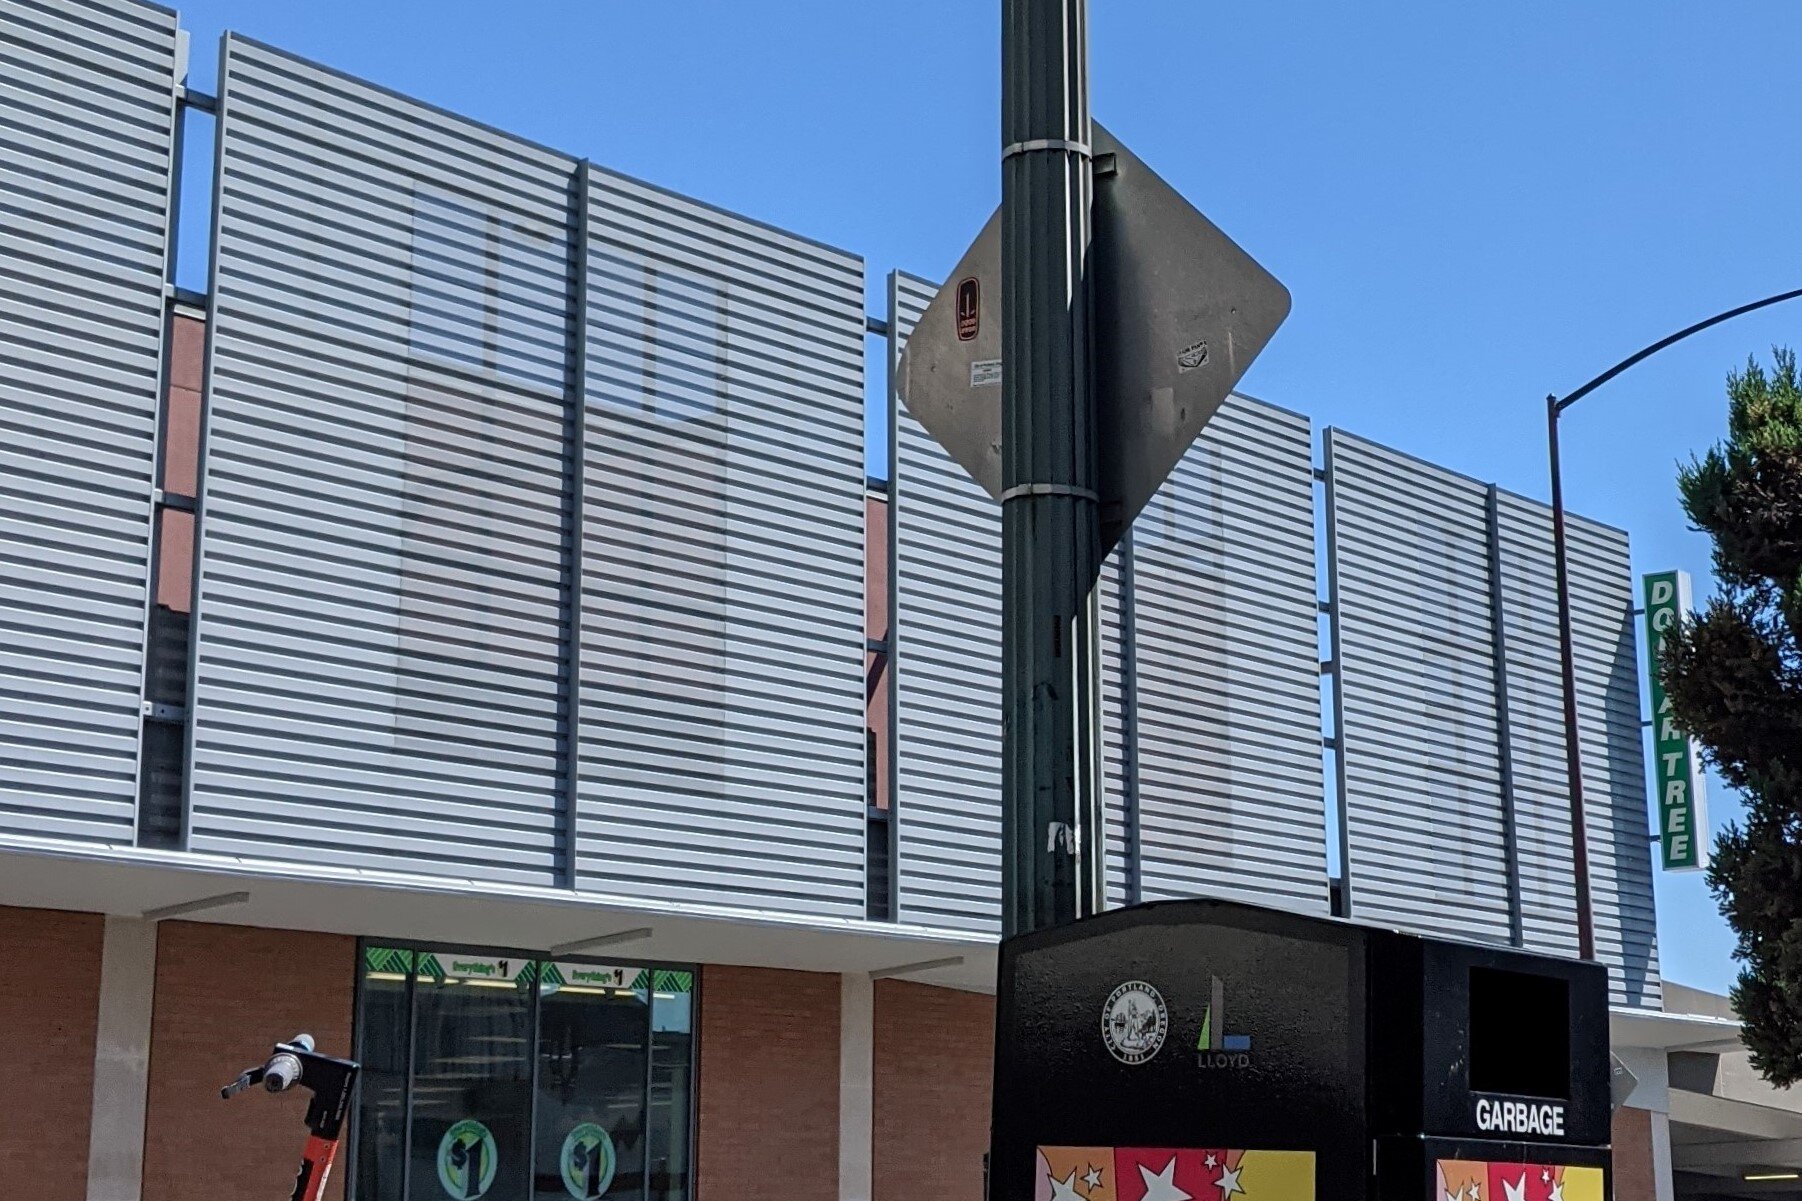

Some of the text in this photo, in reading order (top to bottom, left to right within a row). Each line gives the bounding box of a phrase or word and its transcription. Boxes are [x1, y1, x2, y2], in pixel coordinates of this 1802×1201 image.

[1651, 580, 1689, 861] DOAR TREE
[1198, 1053, 1250, 1068] LLOYD
[1476, 1099, 1564, 1136] GARBAGE
[451, 1137, 483, 1199] $1
[573, 1140, 602, 1199] $1
